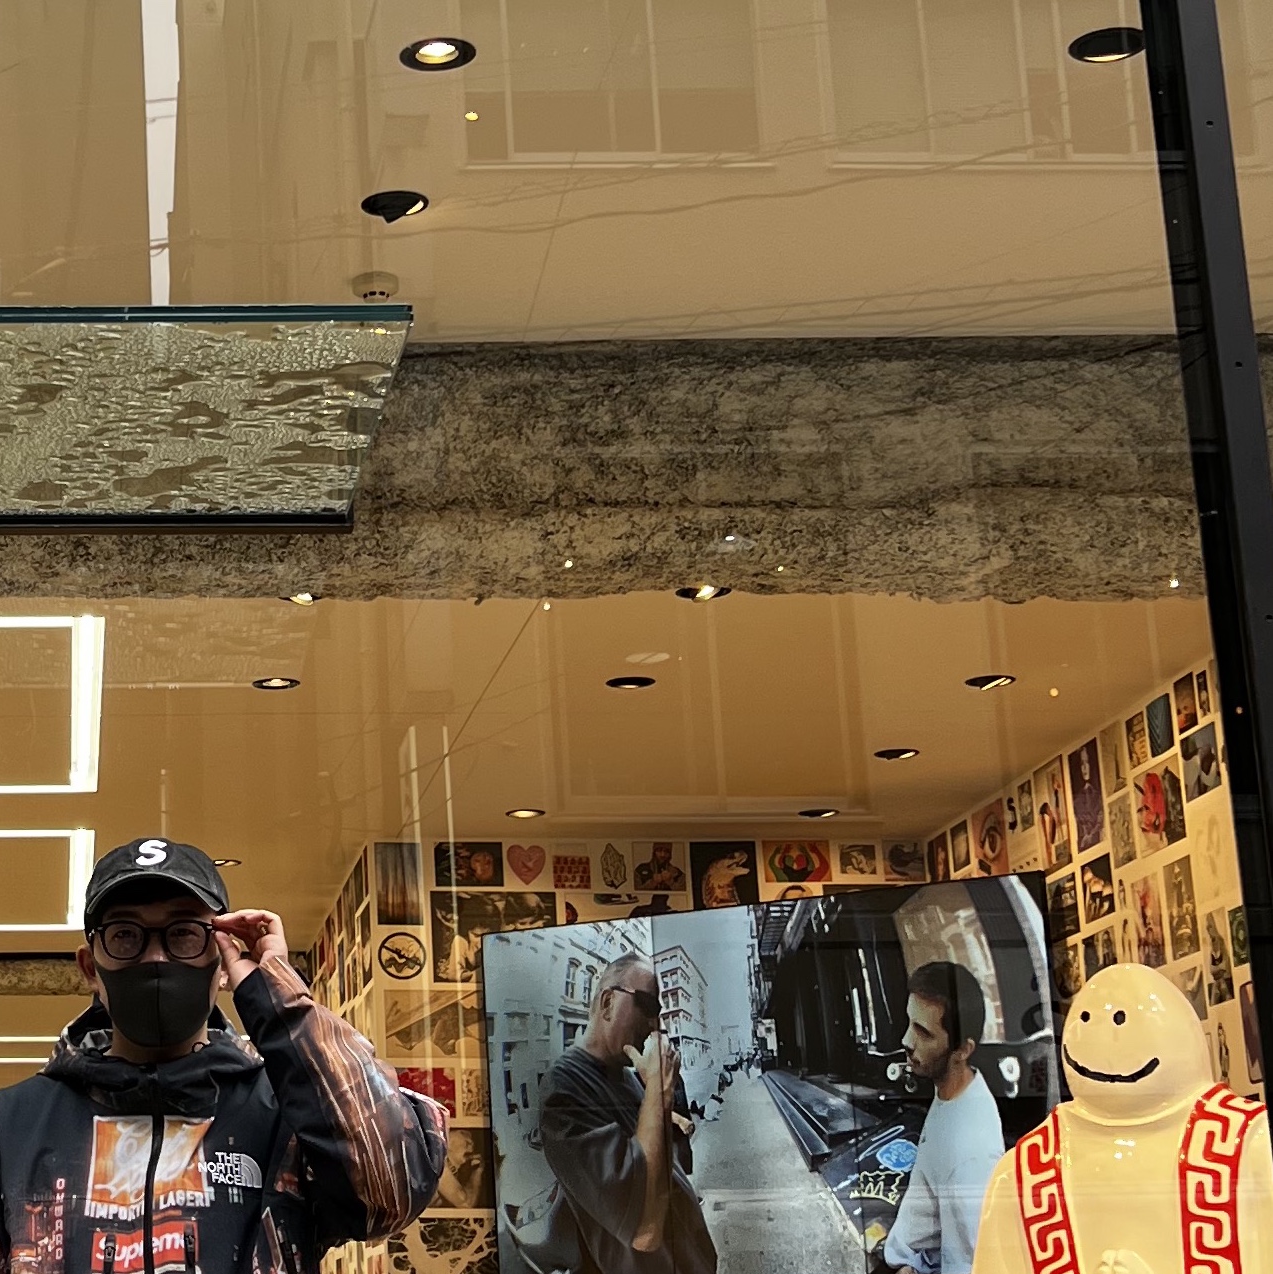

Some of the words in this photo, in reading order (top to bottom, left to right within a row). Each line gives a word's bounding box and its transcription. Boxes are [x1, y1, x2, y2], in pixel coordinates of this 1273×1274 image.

[135, 839, 168, 866] S
[214, 1152, 242, 1165] THE
[197, 1161, 242, 1174] NORTH
[211, 1172, 243, 1185] FACE
[88, 1200, 145, 1222] IMPORT
[95, 1231, 186, 1268] Supem
